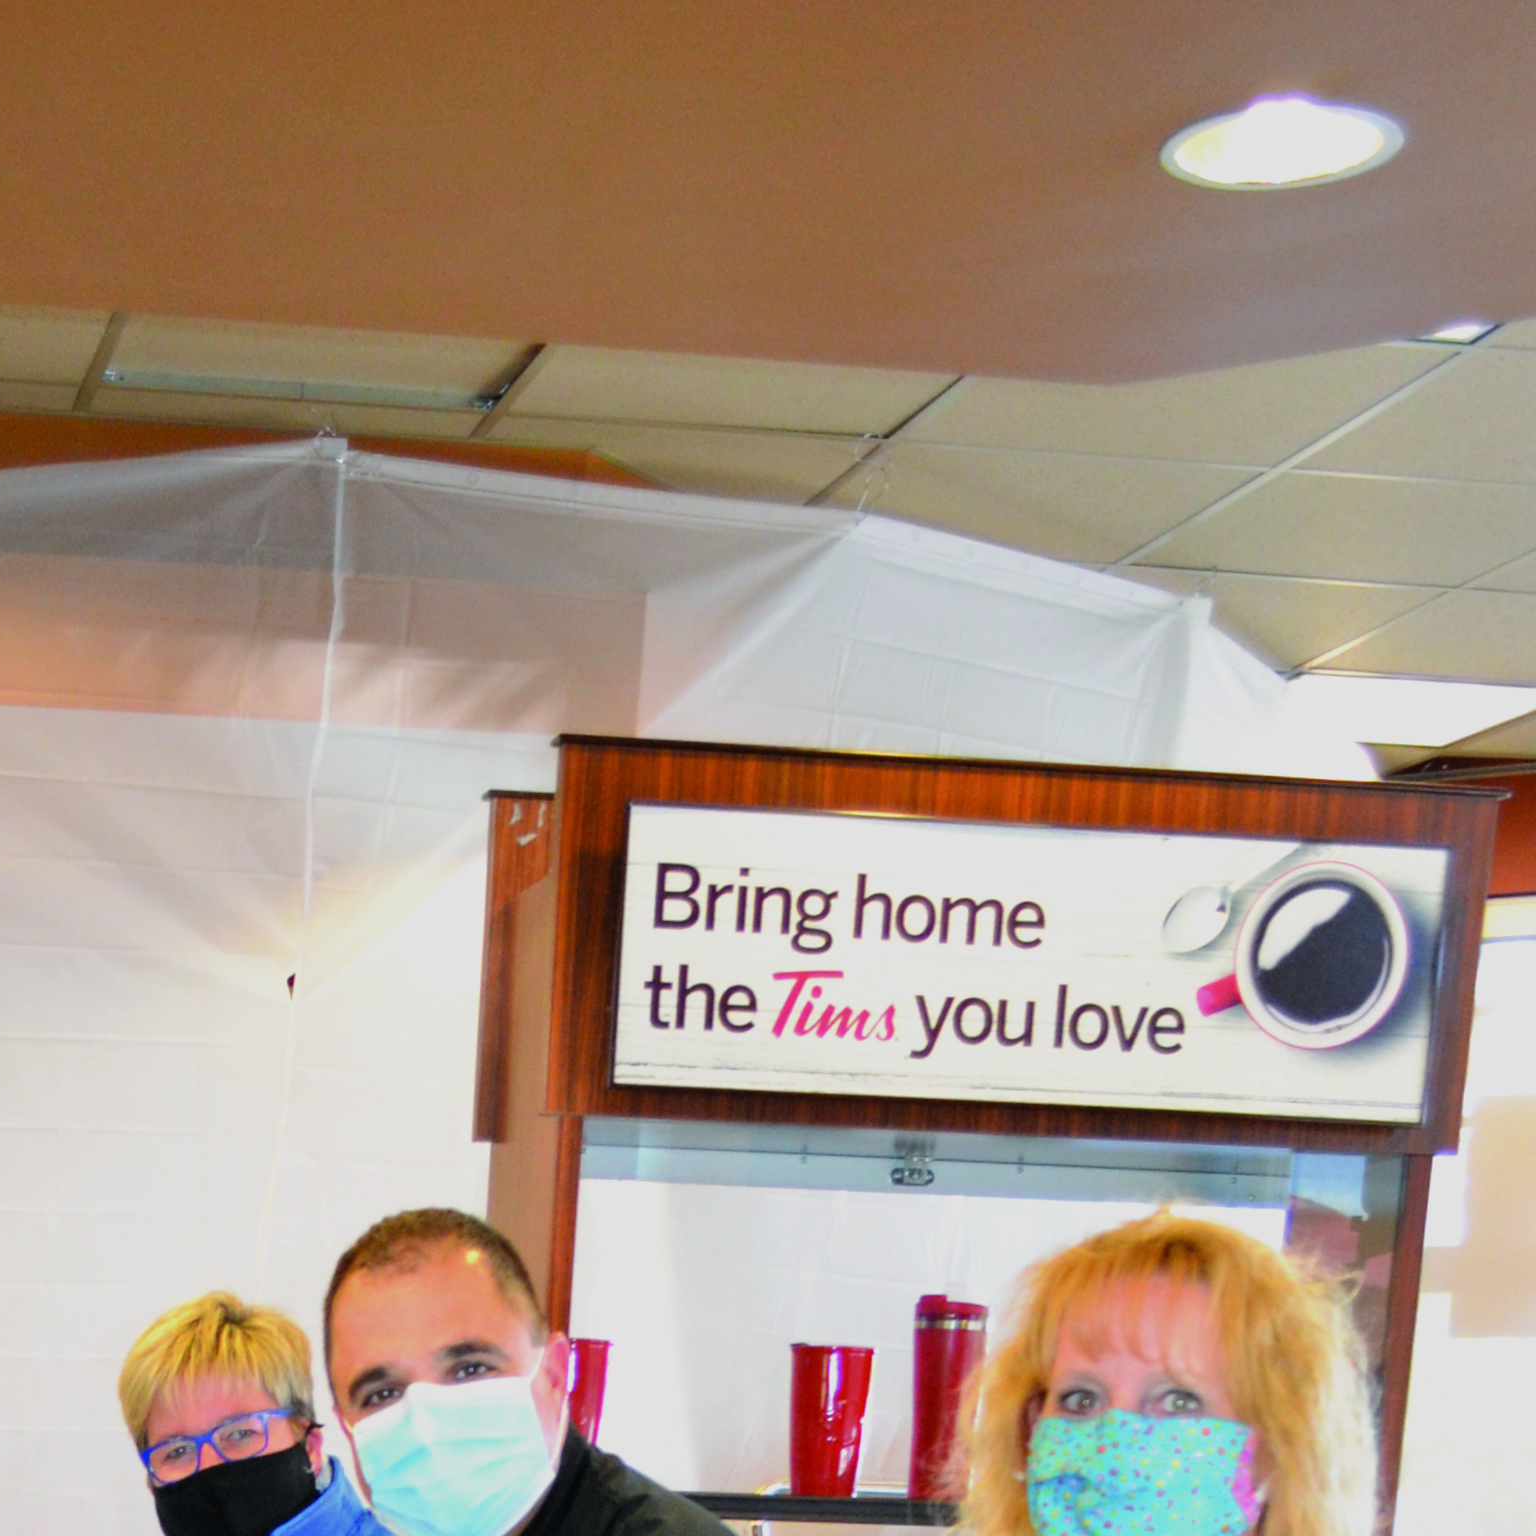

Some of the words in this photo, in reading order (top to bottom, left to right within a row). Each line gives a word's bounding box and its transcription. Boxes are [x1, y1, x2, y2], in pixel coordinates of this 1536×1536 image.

[652, 862, 839, 955] Bring
[852, 873, 1046, 949] home
[644, 964, 758, 1033] the
[770, 969, 898, 1042] Tims
[908, 994, 1036, 1060] you
[1053, 984, 1186, 1055] love
